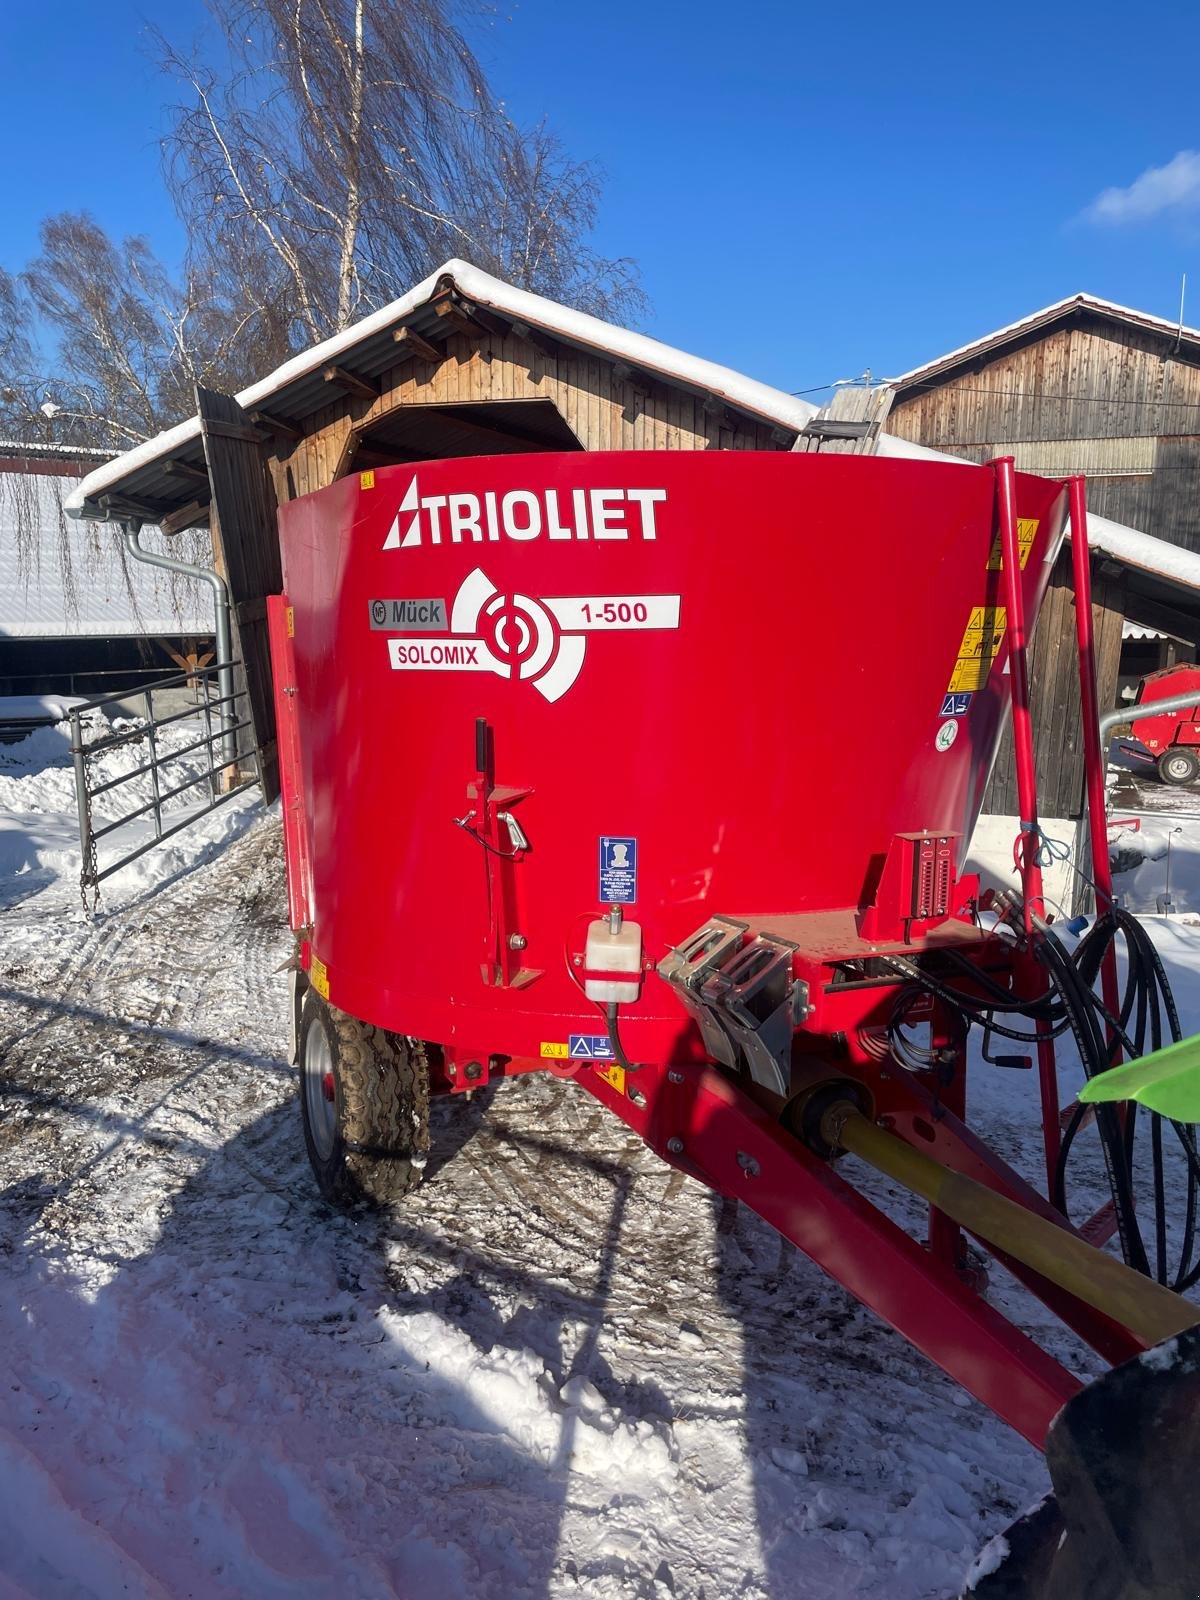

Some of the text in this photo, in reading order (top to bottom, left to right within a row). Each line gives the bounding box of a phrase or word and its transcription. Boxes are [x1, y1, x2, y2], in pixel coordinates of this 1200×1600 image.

[421, 489, 667, 544] TRIOLIET
[392, 600, 441, 623] Mück
[581, 603, 648, 623] 1-500
[398, 646, 480, 665] SOLOMIX
